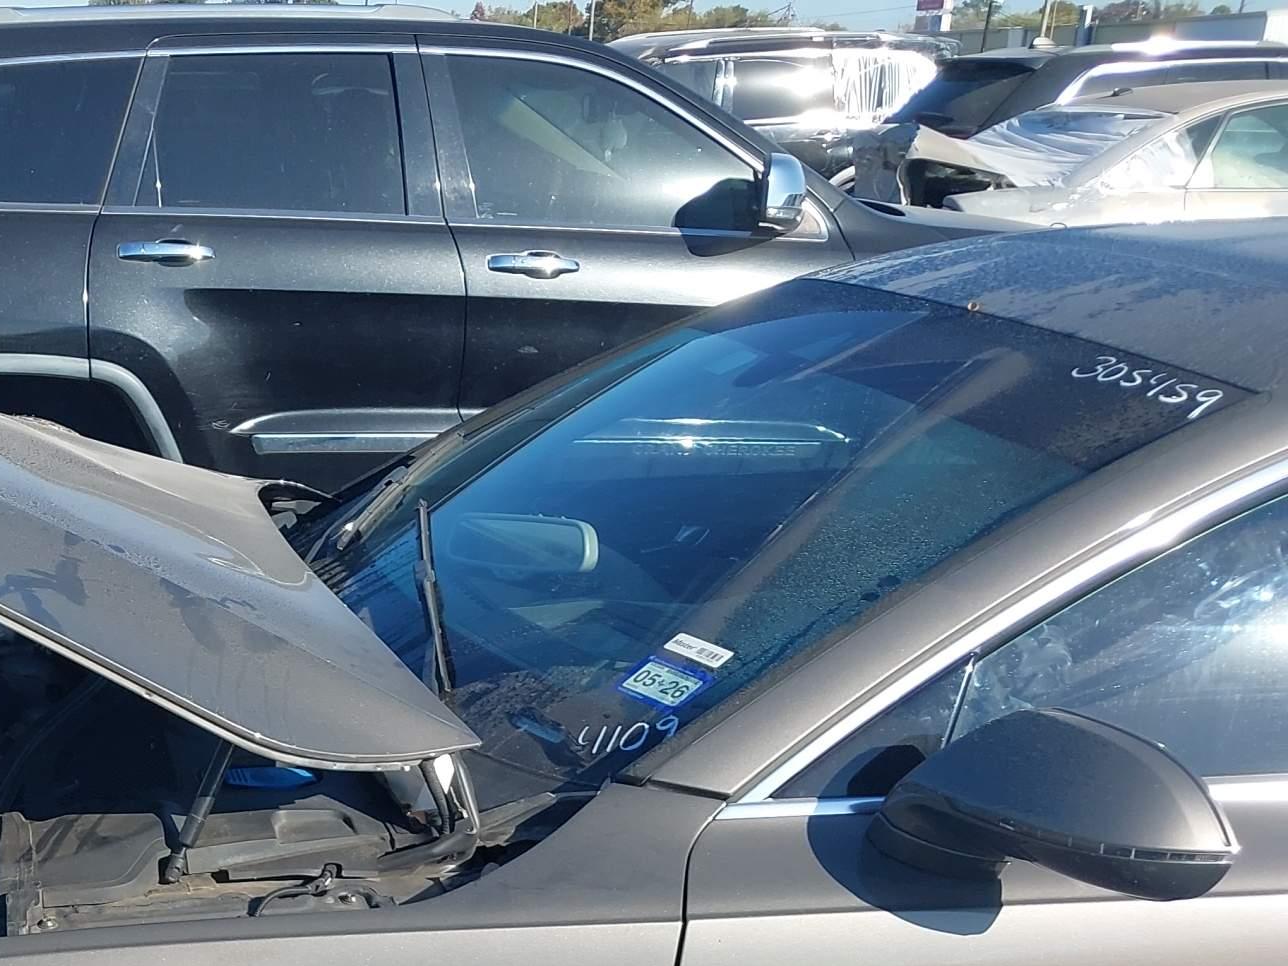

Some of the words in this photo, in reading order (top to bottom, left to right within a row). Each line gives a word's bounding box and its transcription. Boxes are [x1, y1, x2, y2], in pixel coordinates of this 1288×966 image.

[1071, 356, 1224, 419] 305459
[632, 669, 663, 687] 05
[659, 680, 690, 699] 26
[577, 714, 679, 755] 4109
